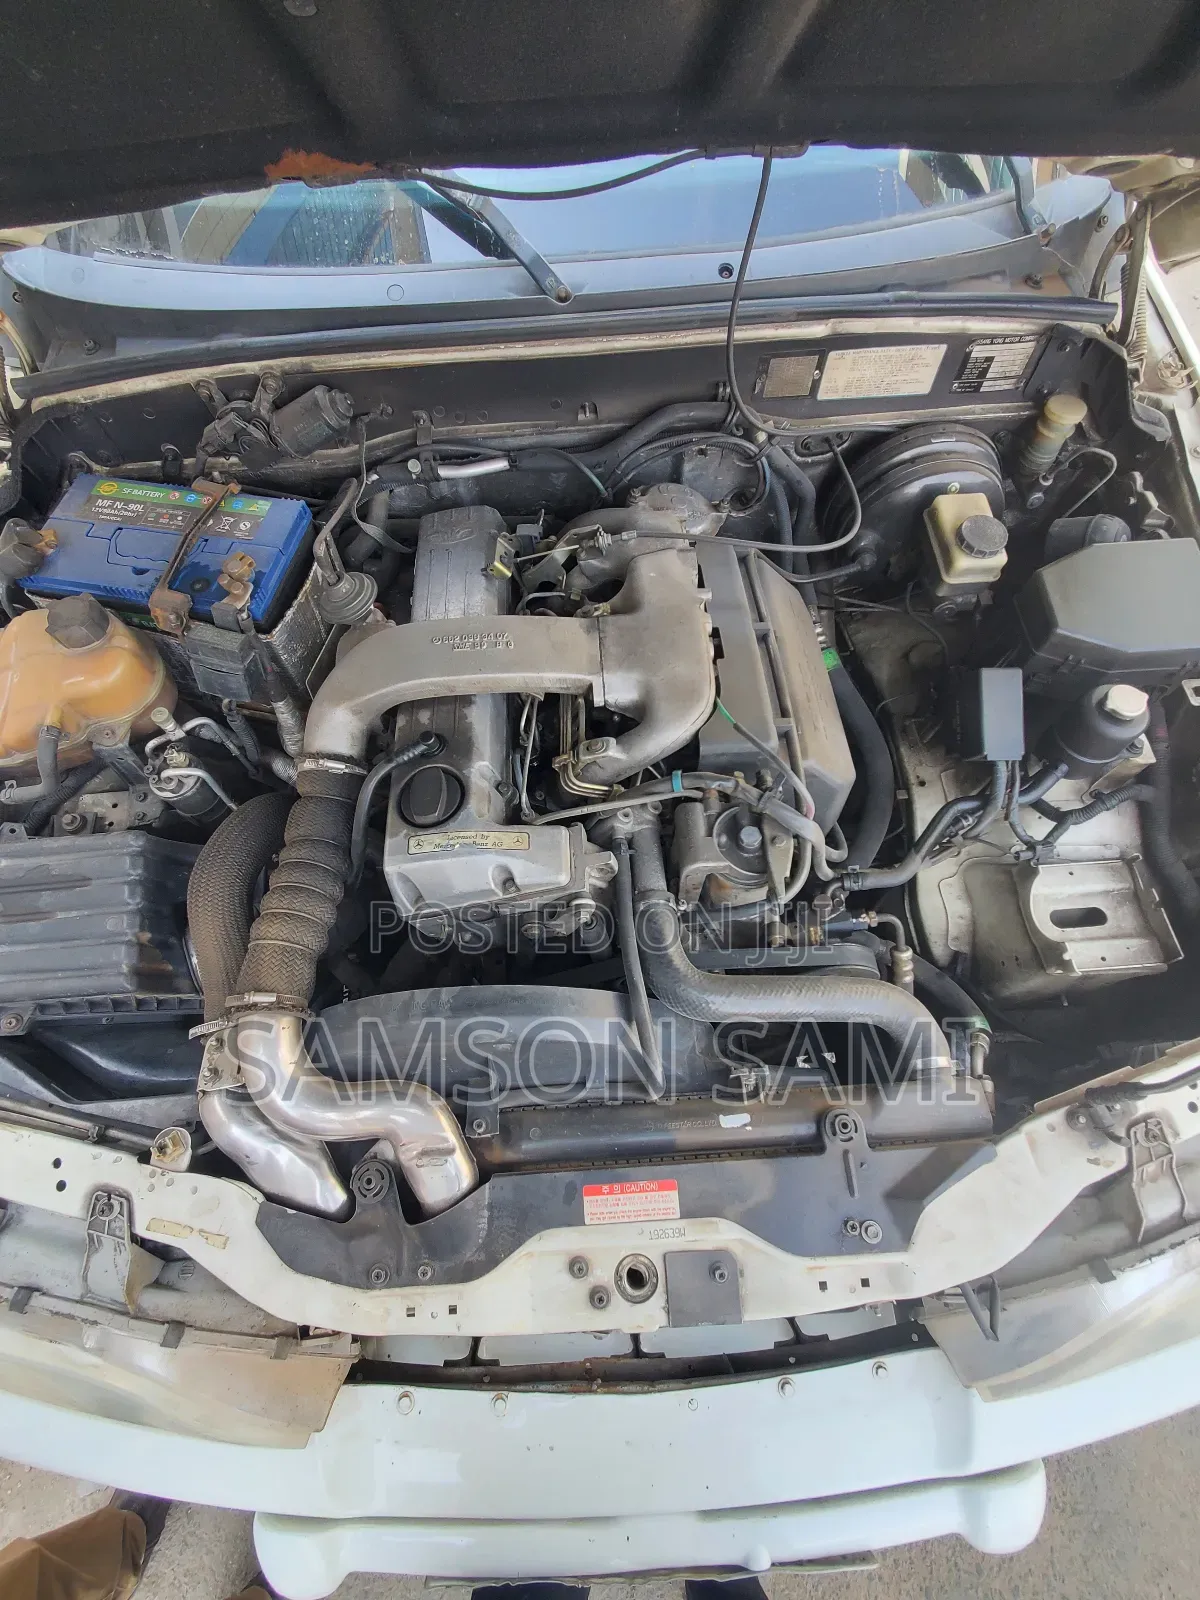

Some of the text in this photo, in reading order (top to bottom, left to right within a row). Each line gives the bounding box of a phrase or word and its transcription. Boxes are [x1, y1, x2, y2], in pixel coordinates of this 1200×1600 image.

[131, 490, 166, 498] BATTERY
[95, 499, 114, 507] MF
[113, 501, 145, 512] N-90L
[447, 833, 491, 841] Licensed by
[623, 1182, 659, 1194] (CAUTION)
[648, 1227, 686, 1241] 192639W
